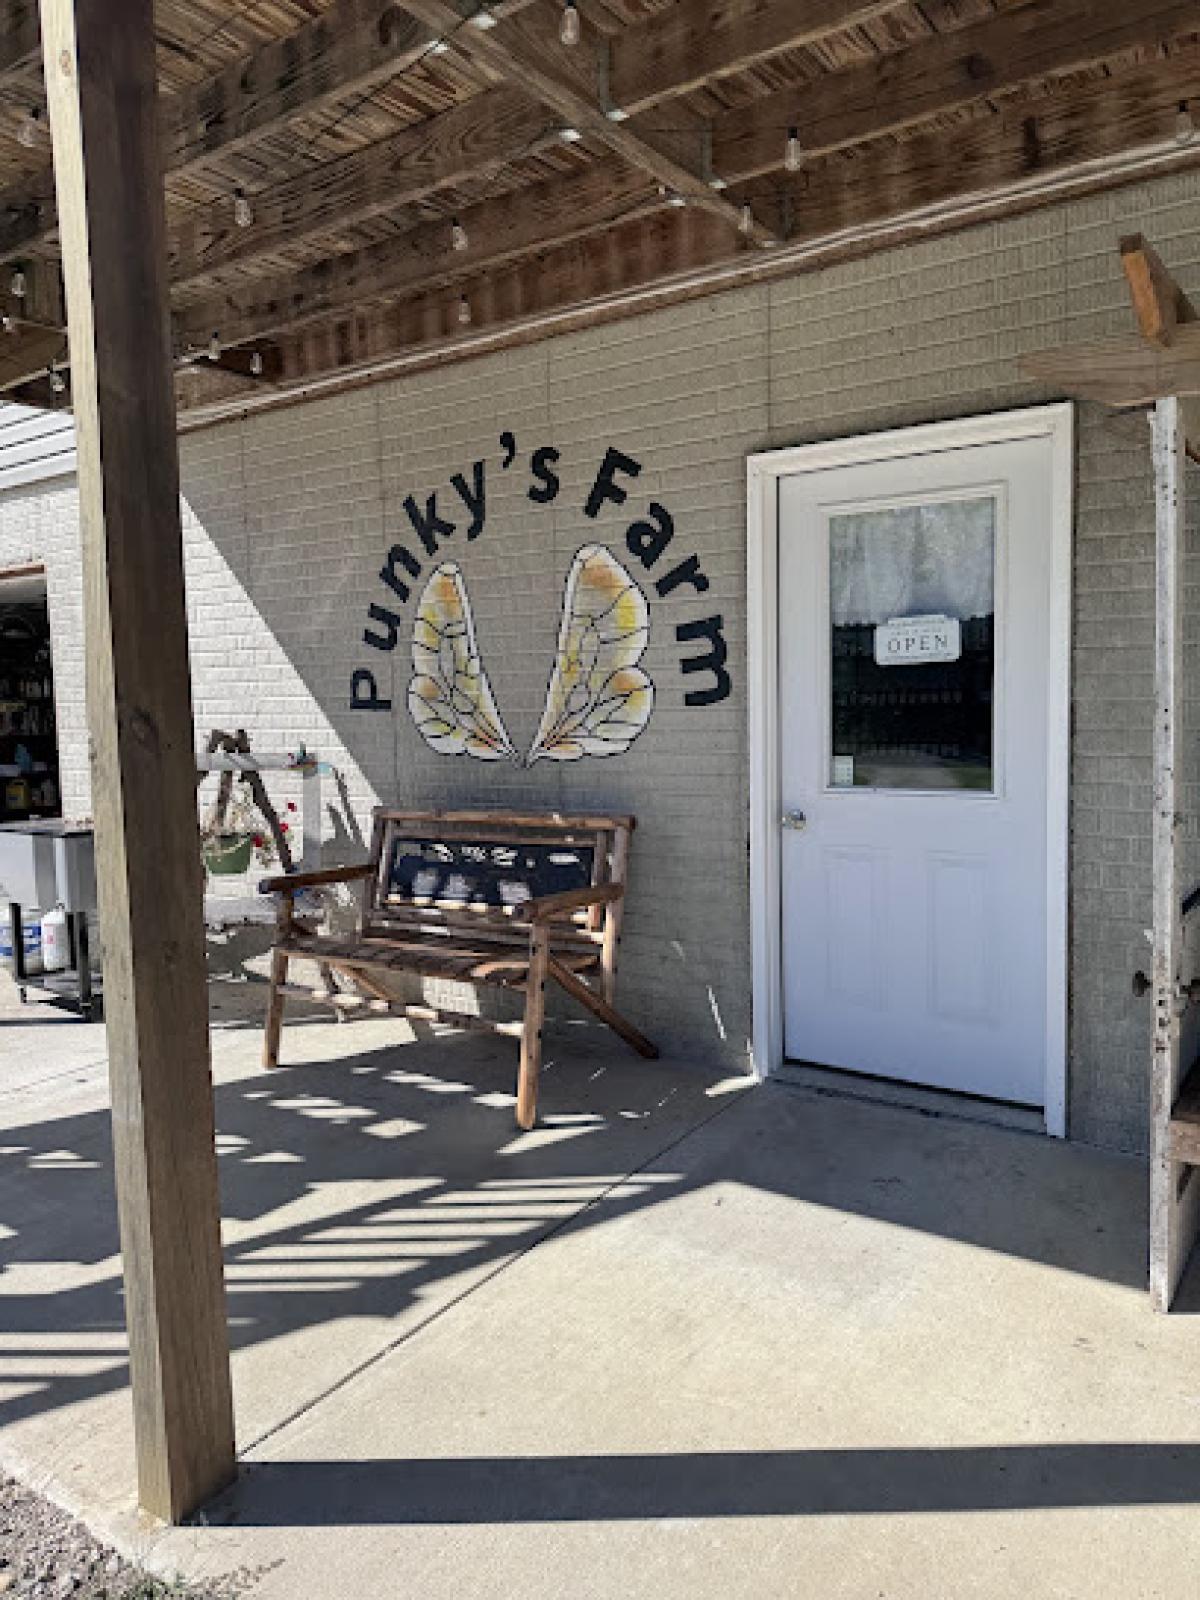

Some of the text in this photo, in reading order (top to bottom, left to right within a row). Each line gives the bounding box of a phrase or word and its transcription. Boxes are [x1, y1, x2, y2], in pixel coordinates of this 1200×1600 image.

[349, 431, 733, 712] Punky's Farm
[887, 634, 948, 654] OPEN
